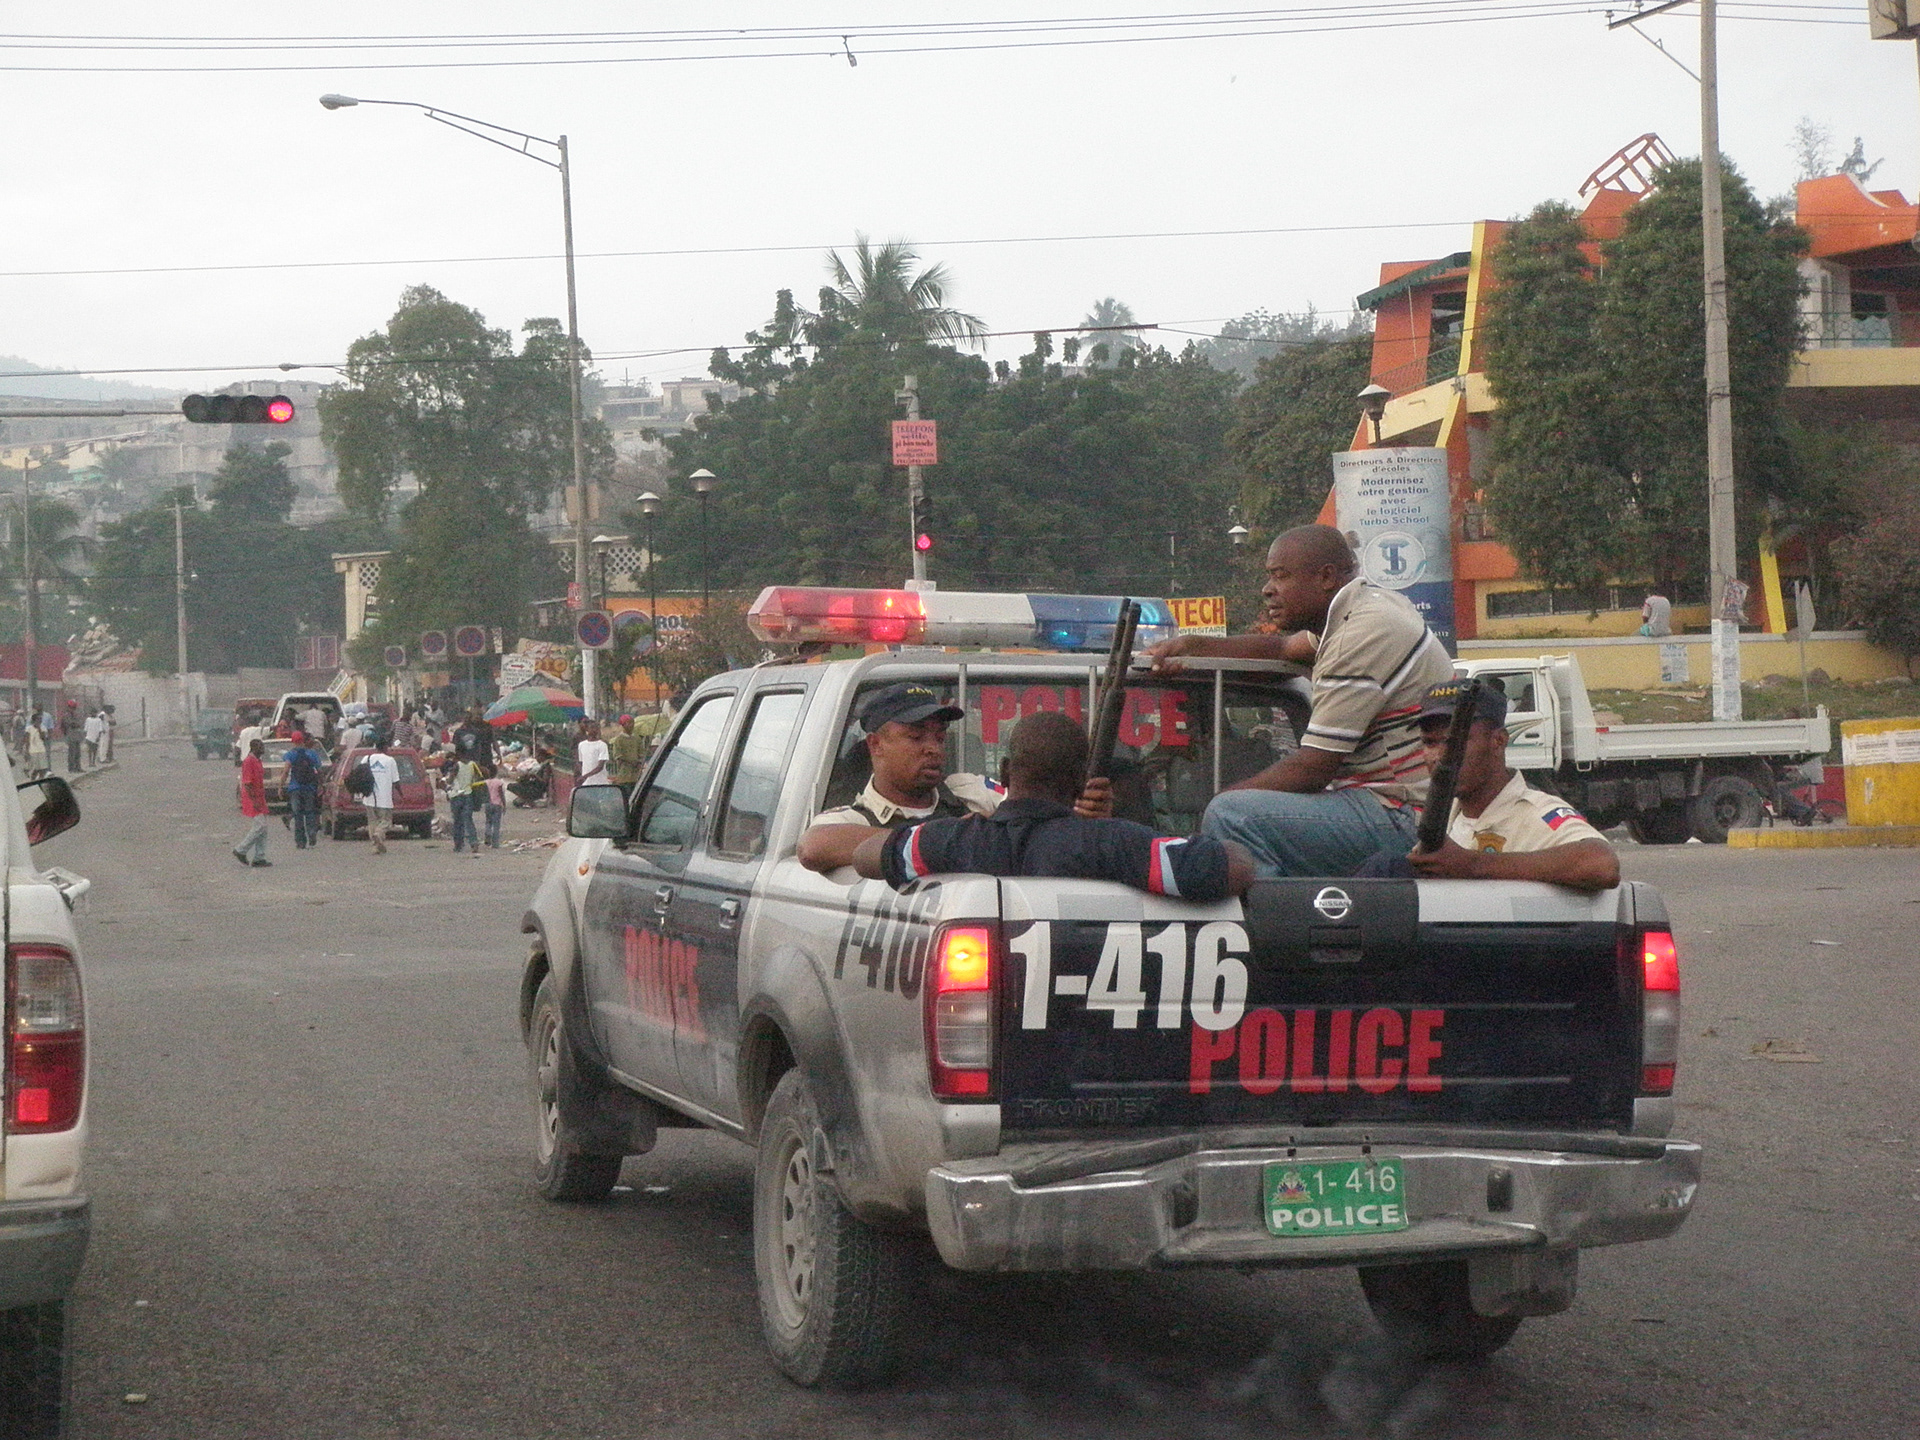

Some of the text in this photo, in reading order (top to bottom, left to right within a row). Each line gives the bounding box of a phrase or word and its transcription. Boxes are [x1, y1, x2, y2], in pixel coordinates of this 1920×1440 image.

[1340, 458, 1383, 468] Directeurs
[1397, 456, 1442, 464] Directrices
[1361, 477, 1424, 486] Modernisez
[1357, 486, 1429, 497] votre gestion
[1380, 497, 1406, 505] avec
[1380, 506, 1421, 516] logiciel
[1360, 516, 1429, 526] Turbo School
[1166, 598, 1224, 626] TECH
[1009, 921, 1250, 1031] 1-416
[1189, 1008, 1446, 1095] POLICE
[1272, 1204, 1400, 1229] POLICE
